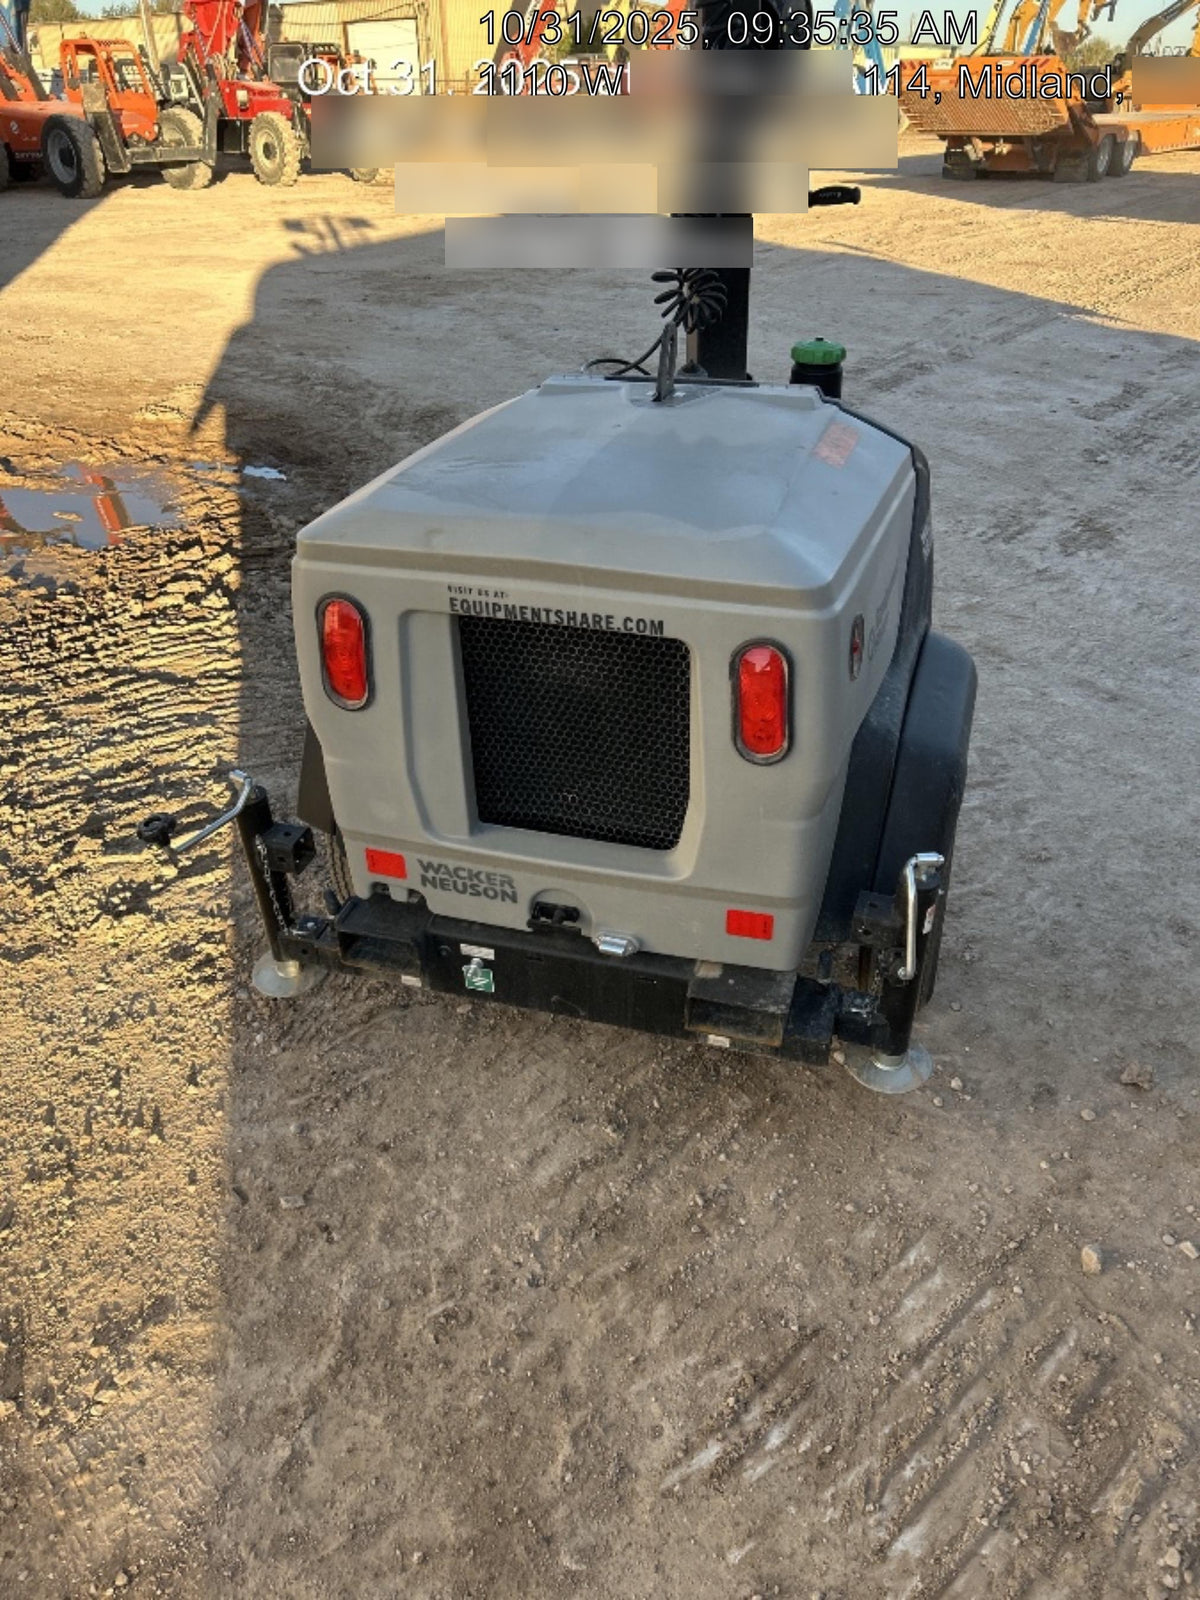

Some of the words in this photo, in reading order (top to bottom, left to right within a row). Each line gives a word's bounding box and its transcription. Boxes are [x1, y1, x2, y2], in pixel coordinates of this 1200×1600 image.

[449, 596, 665, 636] EQUIPMENTSHARE.COM
[417, 858, 516, 889] WACKER
[420, 874, 518, 904] NEUSON
